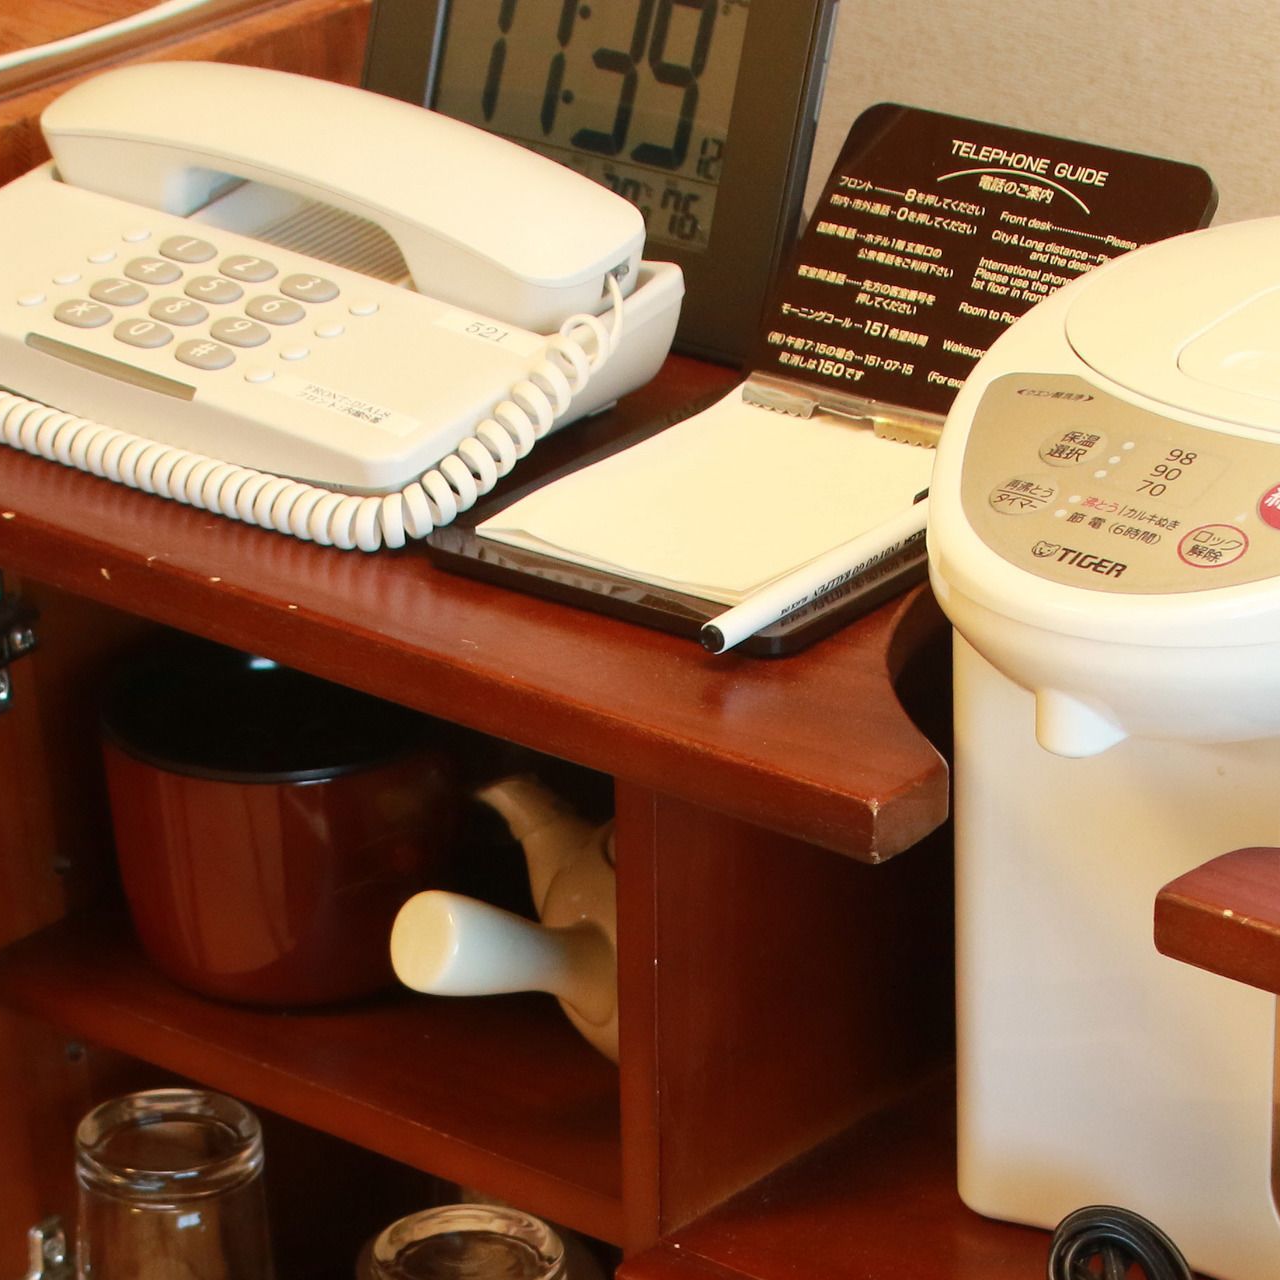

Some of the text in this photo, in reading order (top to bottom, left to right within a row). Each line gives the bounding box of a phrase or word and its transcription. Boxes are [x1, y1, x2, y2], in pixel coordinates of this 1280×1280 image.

[951, 139, 1109, 187] TELEPHONE GUIDE
[839, 175, 874, 192] フロント
[978, 174, 1054, 204] 電話のご案内
[1000, 211, 1028, 226] Front
[1029, 251, 1049, 263] and
[1050, 255, 1067, 267] the
[1047, 242, 1089, 260] distance
[978, 257, 1041, 280] International
[974, 268, 1009, 284] Please
[1010, 277, 1029, 288] use
[1031, 281, 1049, 293] the
[1010, 287, 1021, 298] in
[856, 292, 917, 315] 押してください
[958, 301, 988, 318] Room
[988, 309, 1000, 320] to
[781, 302, 853, 328] モーニングコール
[465, 321, 509, 342] 521
[1060, 431, 1101, 448] 保温
[1046, 443, 1087, 462] 選択
[1166, 448, 1198, 466] 98
[1149, 464, 1182, 481] 90
[1135, 480, 1167, 497] 70
[1192, 530, 1244, 551] ロック
[1056, 547, 1128, 578] TIGER
[1186, 544, 1223, 563] 解除
